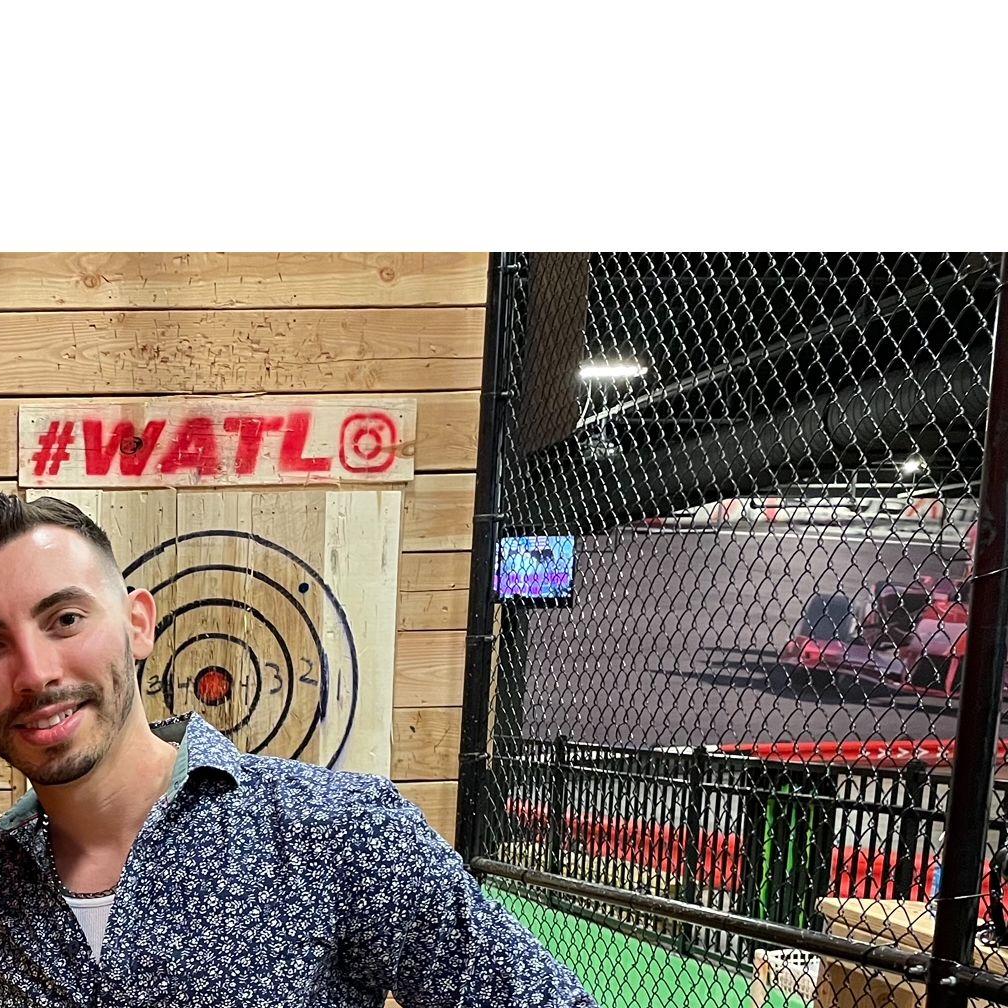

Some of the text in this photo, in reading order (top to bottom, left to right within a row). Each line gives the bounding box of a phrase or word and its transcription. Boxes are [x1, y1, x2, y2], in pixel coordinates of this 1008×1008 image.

[32, 412, 332, 476] #WATL
[265, 662, 283, 695] 3
[299, 656, 319, 686] 2
